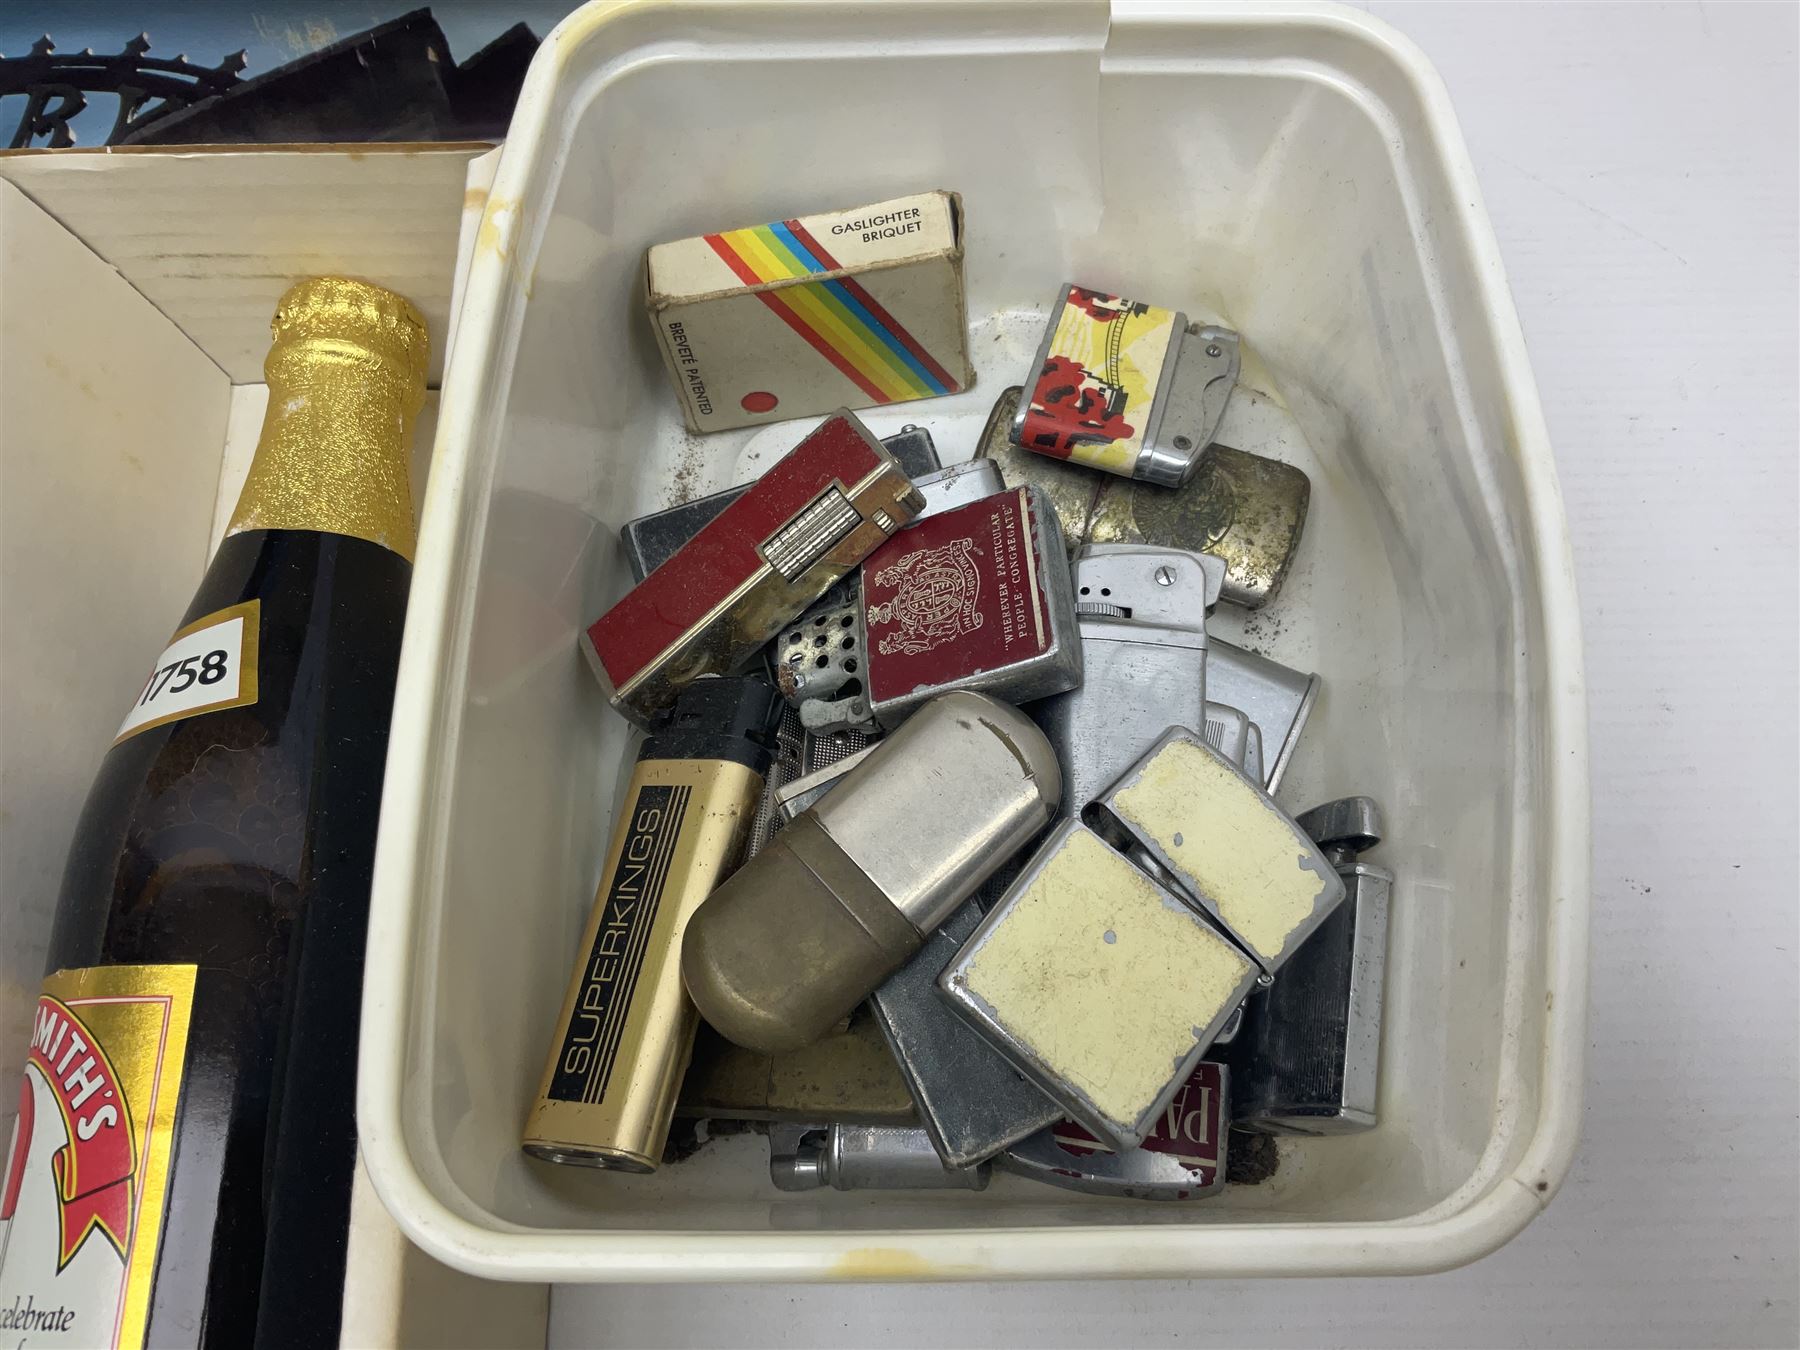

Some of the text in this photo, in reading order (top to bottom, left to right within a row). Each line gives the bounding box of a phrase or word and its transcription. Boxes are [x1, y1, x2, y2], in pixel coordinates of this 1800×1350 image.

[831, 207, 920, 235] GASLIGHTER
[862, 221, 922, 243] BRIQUET
[668, 322, 698, 365] BREVETÉ
[685, 369, 713, 415] PATENTED
[990, 512, 1007, 577] PARTICULAR
[965, 569, 977, 597] SIGNO
[962, 598, 973, 617] HOC
[1014, 592, 1028, 638] PEOPLE
[140, 649, 229, 707] 1758
[563, 808, 662, 1075] SUPERKINGS
[1147, 1084, 1213, 1145] PA
